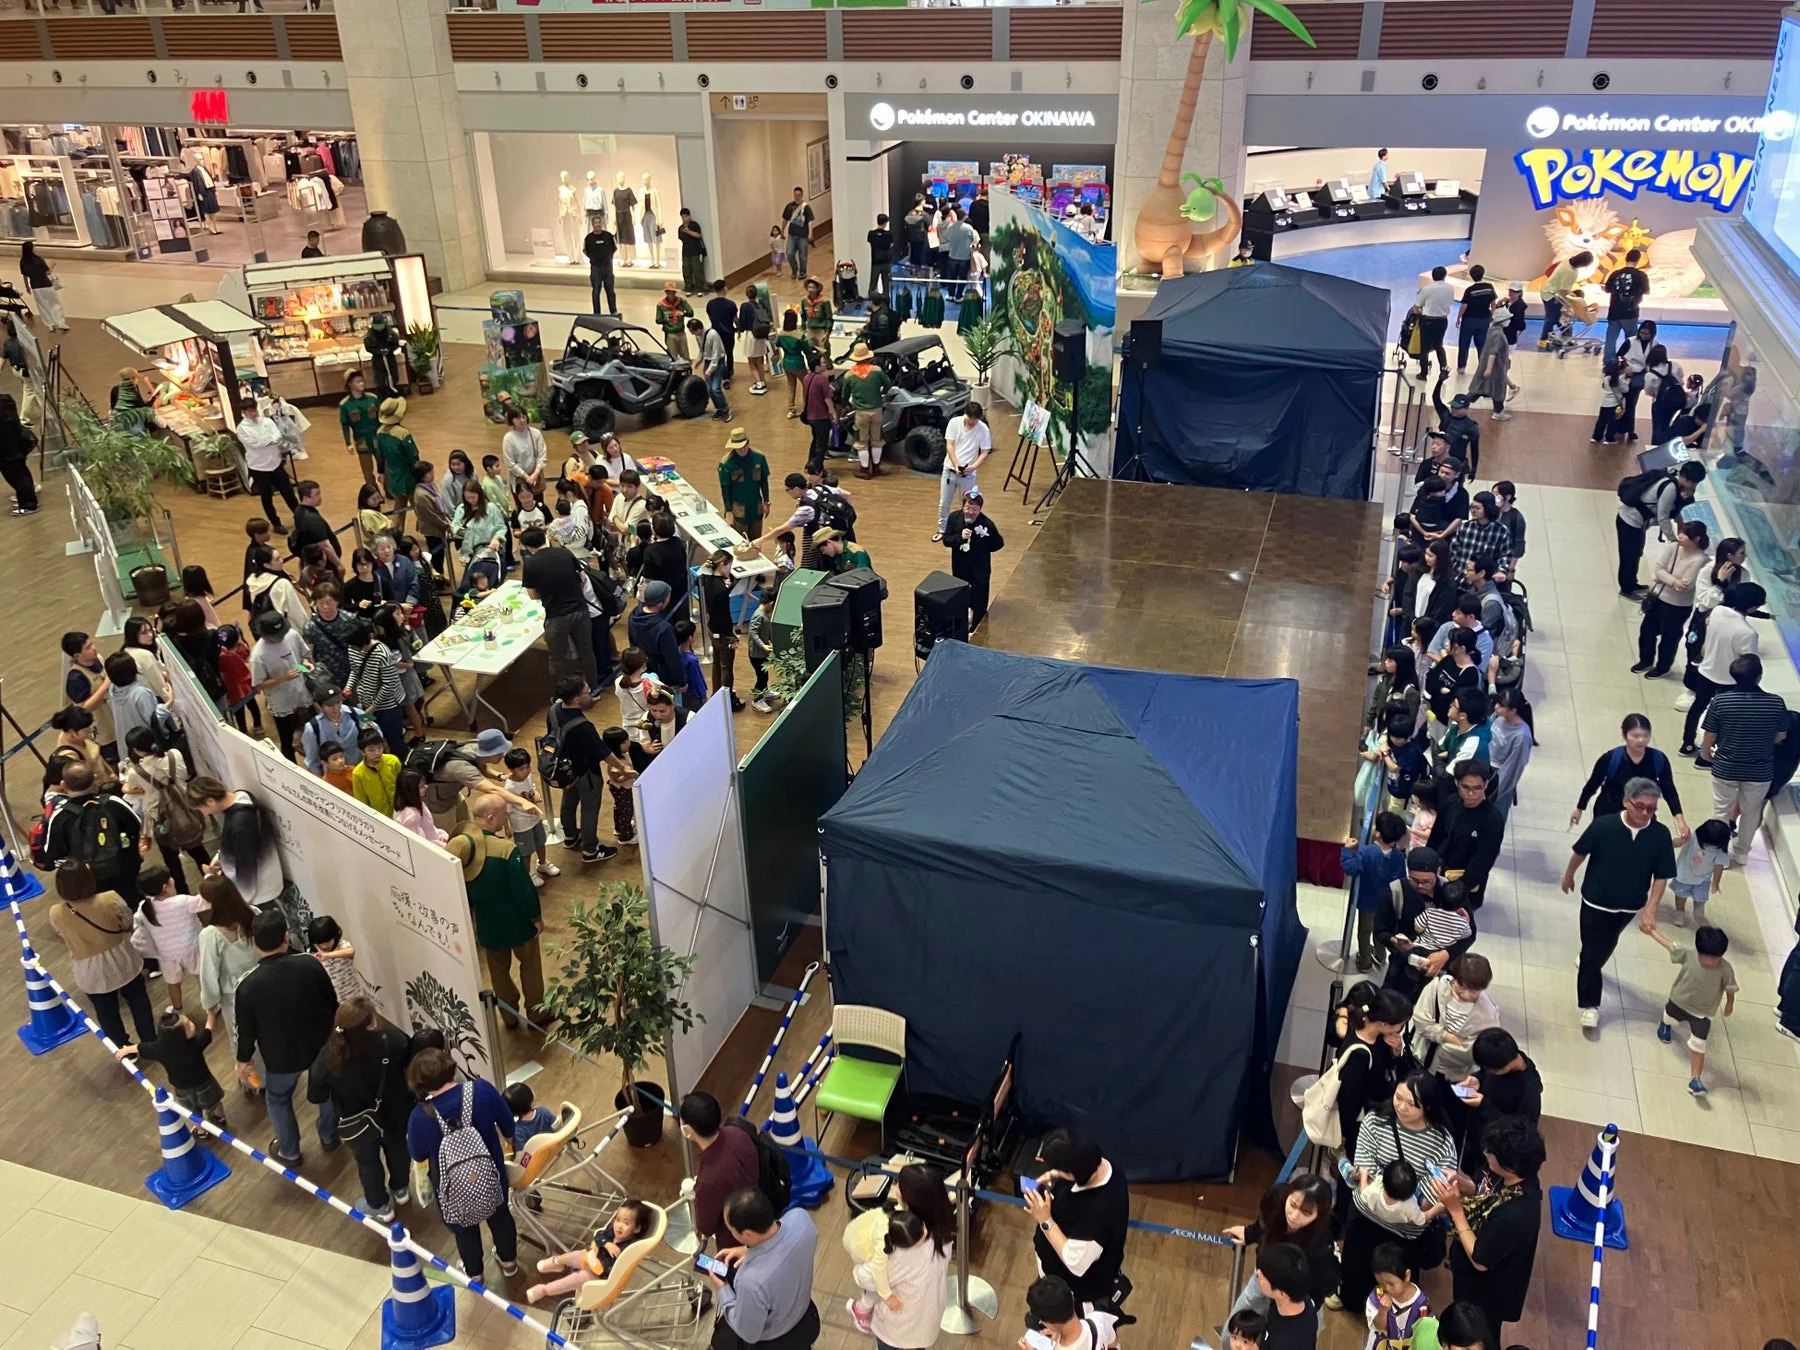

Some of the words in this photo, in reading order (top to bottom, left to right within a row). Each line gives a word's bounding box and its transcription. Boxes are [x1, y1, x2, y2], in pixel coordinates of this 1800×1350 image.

[897, 108, 965, 126] Pokémon
[967, 109, 1019, 126] Center
[1021, 110, 1096, 127] OKINAWA
[1562, 112, 1651, 132] Pokémon
[1654, 114, 1722, 133] Center
[1746, 130, 1766, 212] EVEN
[1197, 1233, 1223, 1245] MALL
